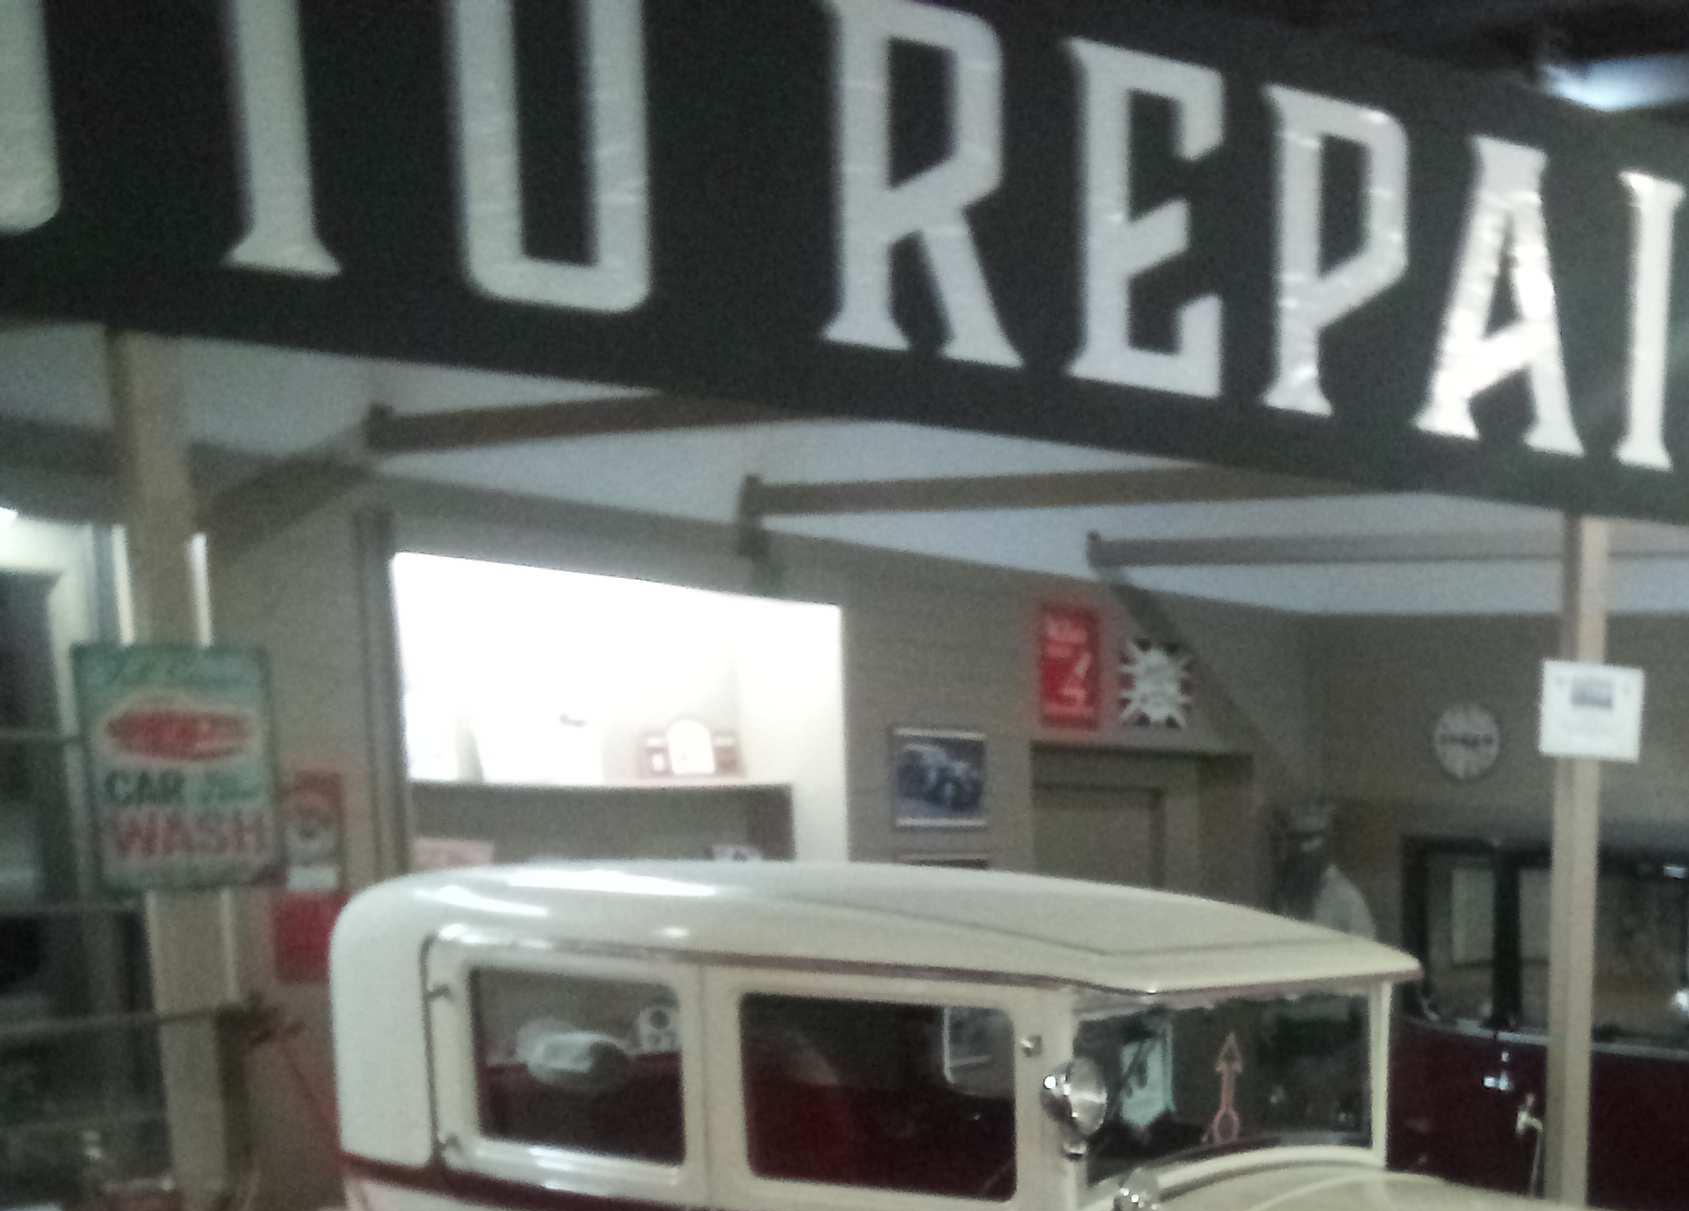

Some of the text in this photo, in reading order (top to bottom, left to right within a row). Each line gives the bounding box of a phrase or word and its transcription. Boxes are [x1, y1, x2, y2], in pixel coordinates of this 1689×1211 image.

[821, 0, 1685, 472] REPAI
[104, 768, 185, 808] CAR
[110, 810, 267, 858] WASH
